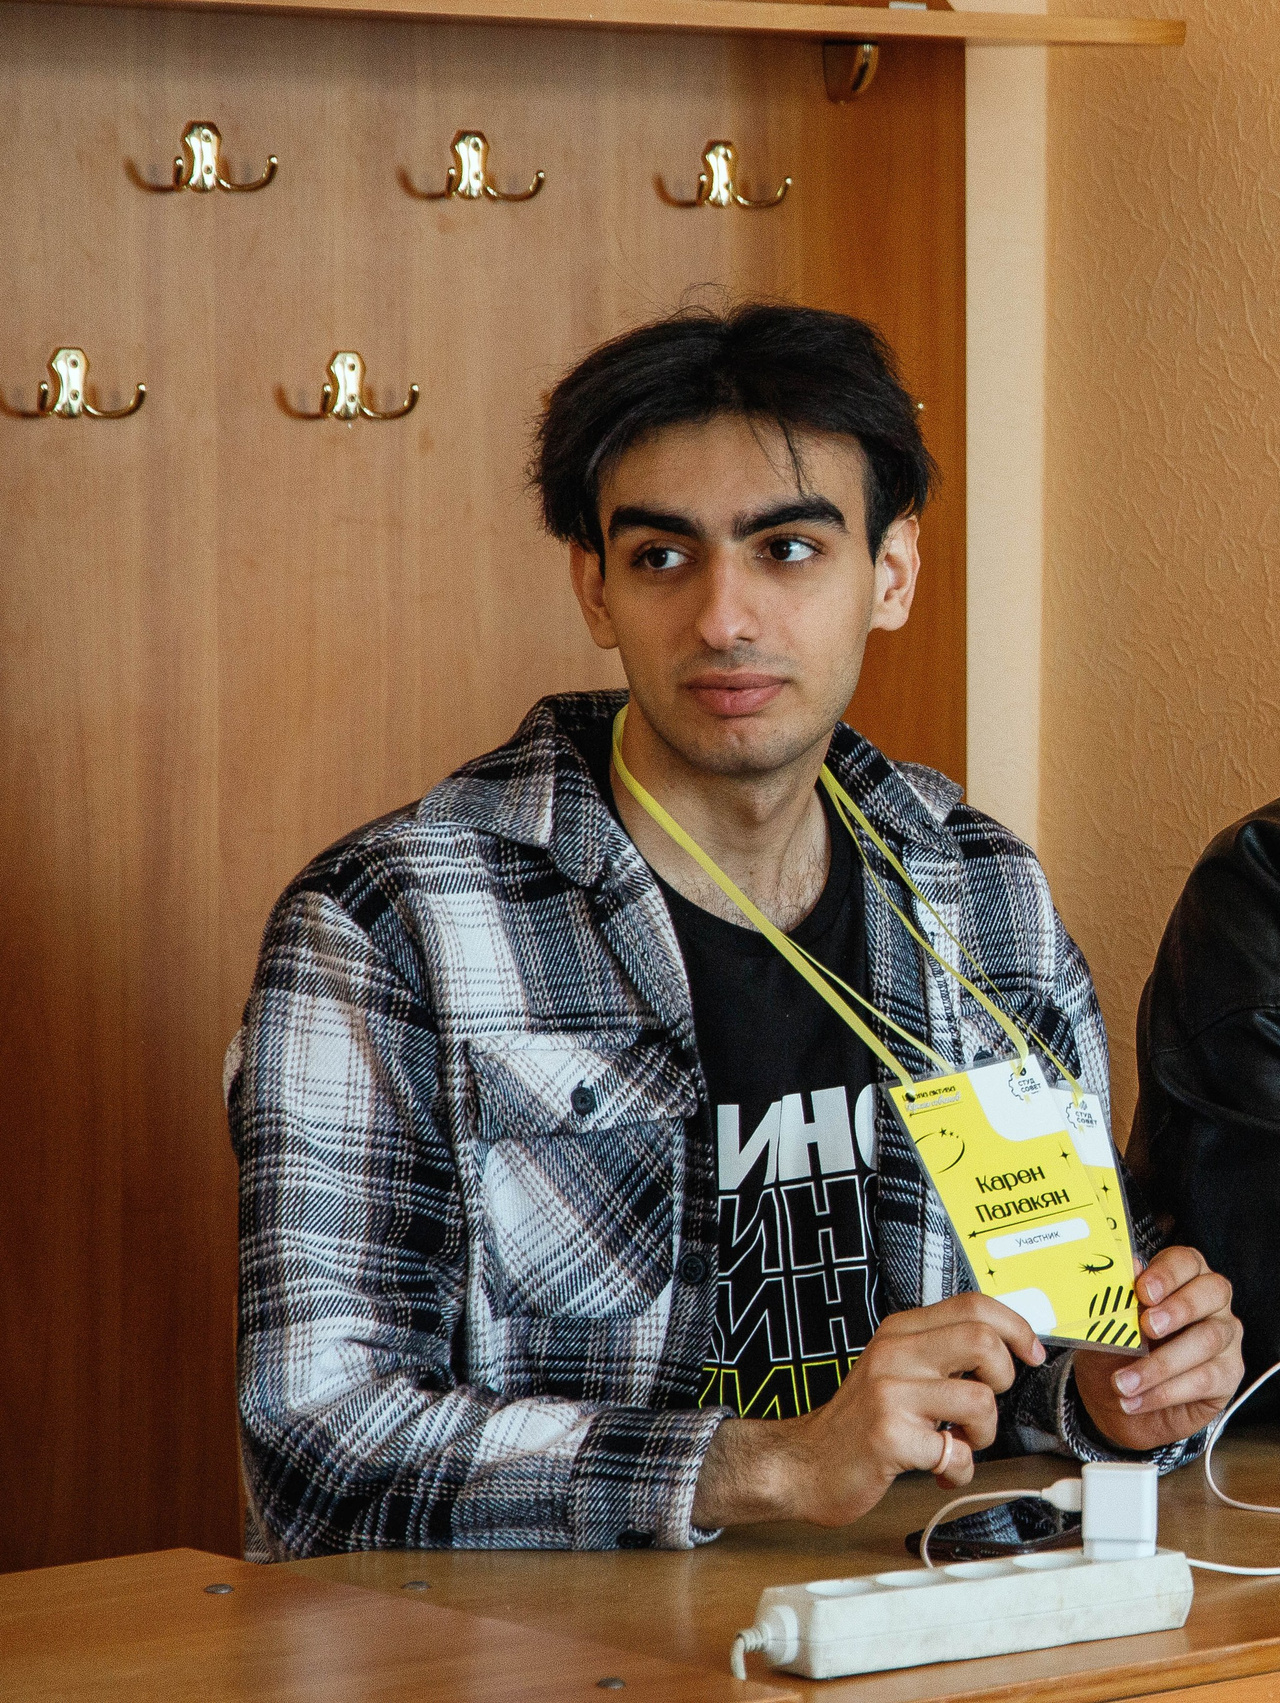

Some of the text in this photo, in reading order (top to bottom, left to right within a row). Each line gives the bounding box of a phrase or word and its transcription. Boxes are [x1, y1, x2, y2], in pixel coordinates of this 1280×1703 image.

[975, 1166, 1046, 1194] Карен
[975, 1188, 1071, 1223] Палакян
[1015, 1230, 1061, 1247] Участник
